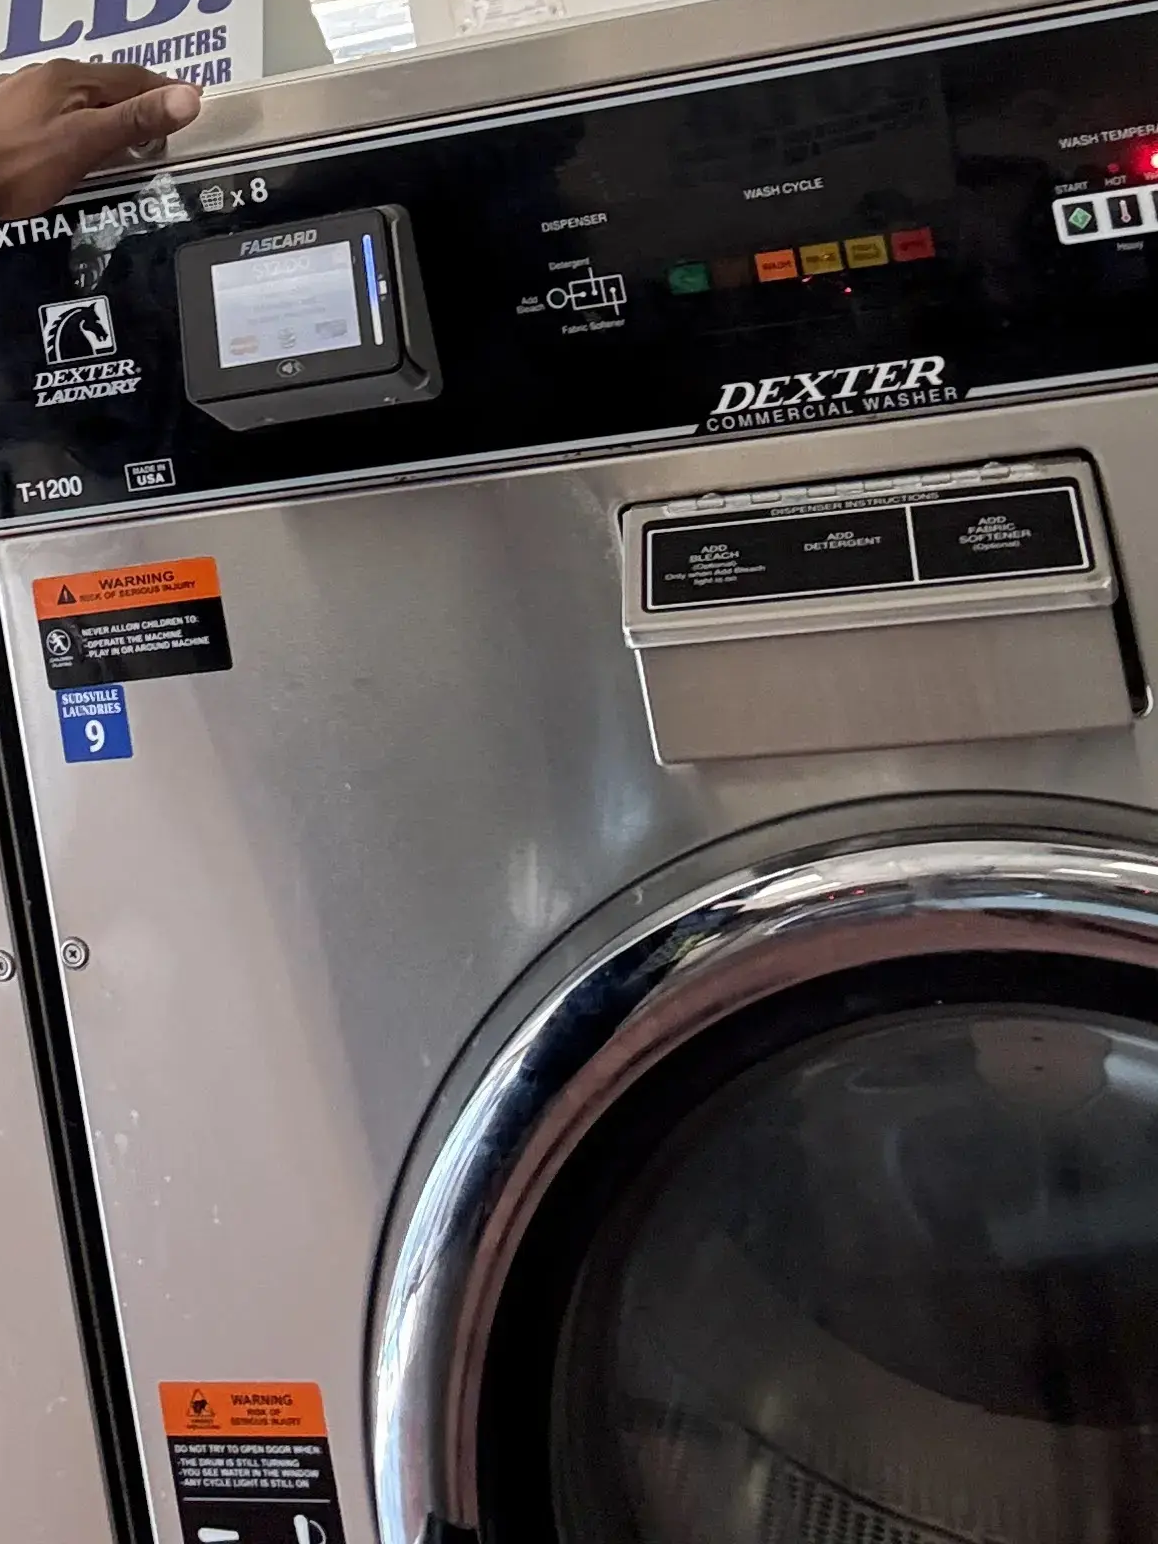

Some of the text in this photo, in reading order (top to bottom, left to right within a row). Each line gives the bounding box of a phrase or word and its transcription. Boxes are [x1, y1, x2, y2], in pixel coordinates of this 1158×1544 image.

[1058, 133, 1099, 149] WASH
[743, 177, 824, 200] WASH CYCLE
[1054, 174, 1127, 195] START HOT
[79, 194, 186, 235] LARGE
[229, 189, 245, 208] x
[249, 177, 268, 203] 8
[540, 212, 608, 233] DISPENSER
[239, 228, 317, 256] FASCARD
[32, 358, 135, 390] DEXTER
[34, 376, 142, 407] LAUNDRY
[709, 355, 945, 415] DEXTER
[705, 386, 958, 433] COMMERCIAL WASHER
[130, 462, 166, 476] MADE IN
[136, 472, 165, 486] USA
[16, 474, 83, 505] T-1200
[770, 492, 939, 517] DISPENSER INSTRUCTIONS
[967, 521, 1016, 534] FABRIC
[977, 515, 1007, 525] ADD
[803, 535, 881, 551] DETERGENT
[826, 531, 854, 541] ADD
[958, 528, 1032, 544] SOFTENER
[688, 549, 740, 563] BLEACH
[700, 543, 728, 554] ADD
[98, 570, 175, 590] WARNING
[79, 580, 195, 602] RISK OF SERIOUS INJURY
[81, 625, 110, 636] NEVER
[110, 622, 140, 633] ALLOW
[140, 616, 184, 630] CHILDREN
[126, 634, 143, 644] THE
[144, 628, 183, 642] MACHINE
[110, 647, 120, 655] IN
[120, 644, 134, 654] OR
[134, 640, 170, 653] AROUND
[170, 635, 210, 648] MACHINE
[62, 688, 119, 705] SUDSVILLE
[62, 702, 122, 719] LAUNDRIES
[84, 719, 106, 753] 9
[230, 1393, 293, 1406] WARNING
[173, 1444, 188, 1453] DO
[188, 1444, 207, 1453] NOT
[207, 1444, 225, 1453] TRY
[226, 1444, 239, 1454] TO
[239, 1444, 265, 1454] OPEN
[265, 1445, 292, 1454] DOOR
[198, 1457, 224, 1467] DRUM
[225, 1458, 234, 1467] IS
[235, 1458, 260, 1467] STILL
[260, 1458, 300, 1467] TURNING
[220, 1468, 250, 1477] WATER
[251, 1468, 262, 1477] IN
[262, 1468, 279, 1477] THE
[281, 1469, 319, 1478] WINDOW
[202, 1477, 232, 1487] CYCLE
[232, 1478, 258, 1487] LIGHT
[269, 1478, 294, 1488] STILL
[295, 1479, 309, 1488] ON
